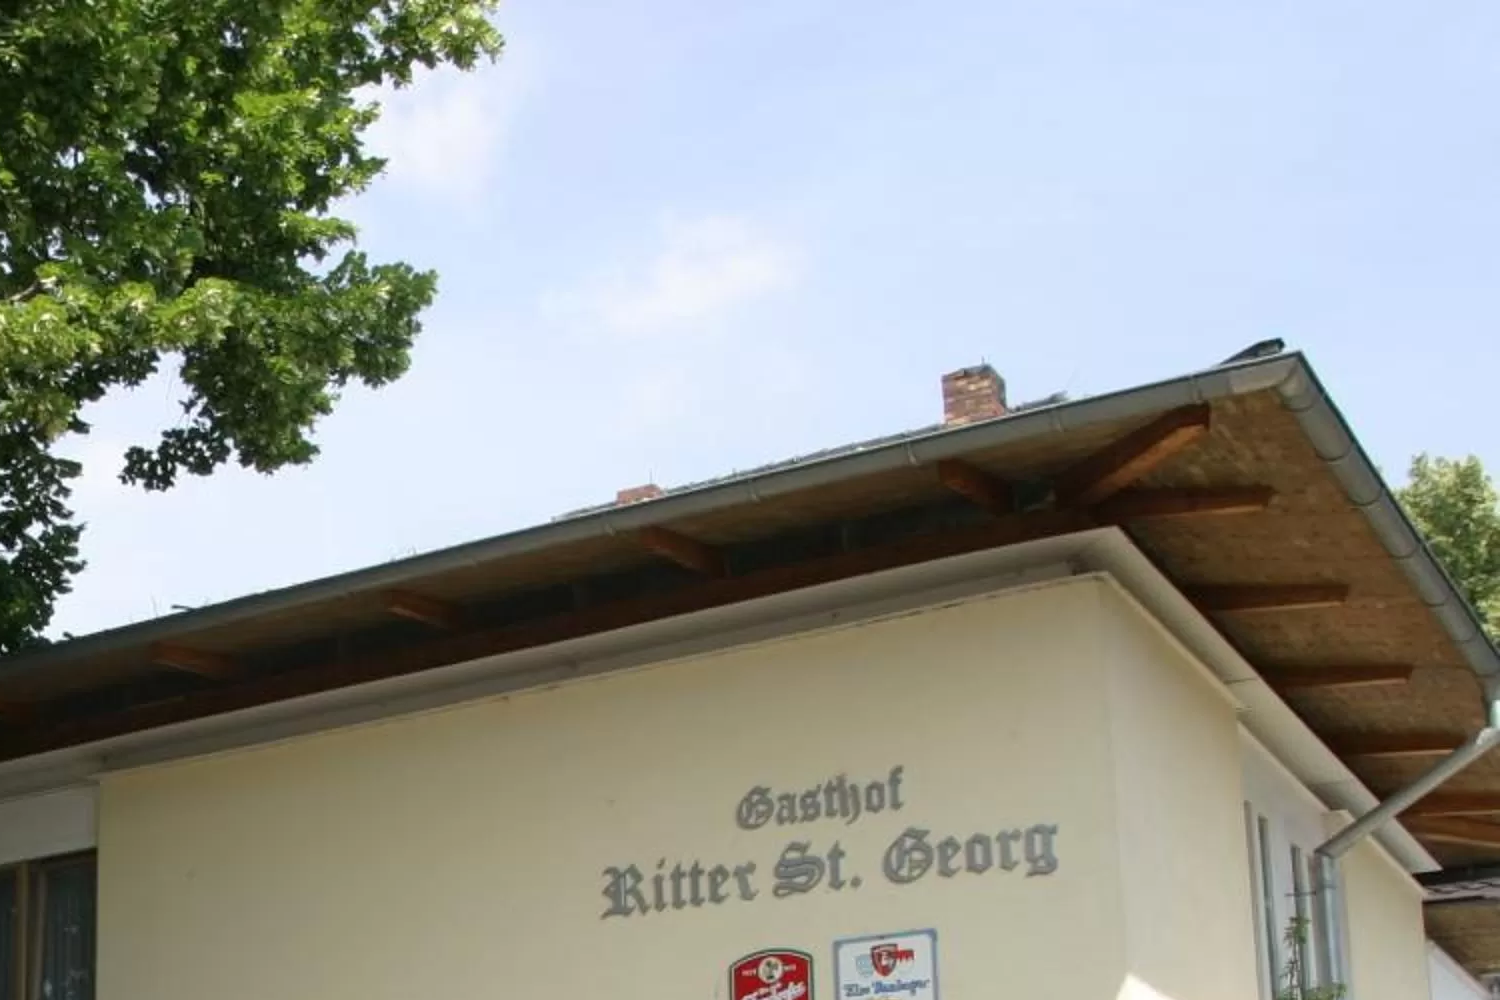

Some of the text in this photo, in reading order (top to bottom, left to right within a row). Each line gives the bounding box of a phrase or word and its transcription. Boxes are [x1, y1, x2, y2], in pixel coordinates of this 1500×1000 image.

[735, 765, 904, 829] Gasthof
[600, 824, 1059, 919] Ritter St. Georg
